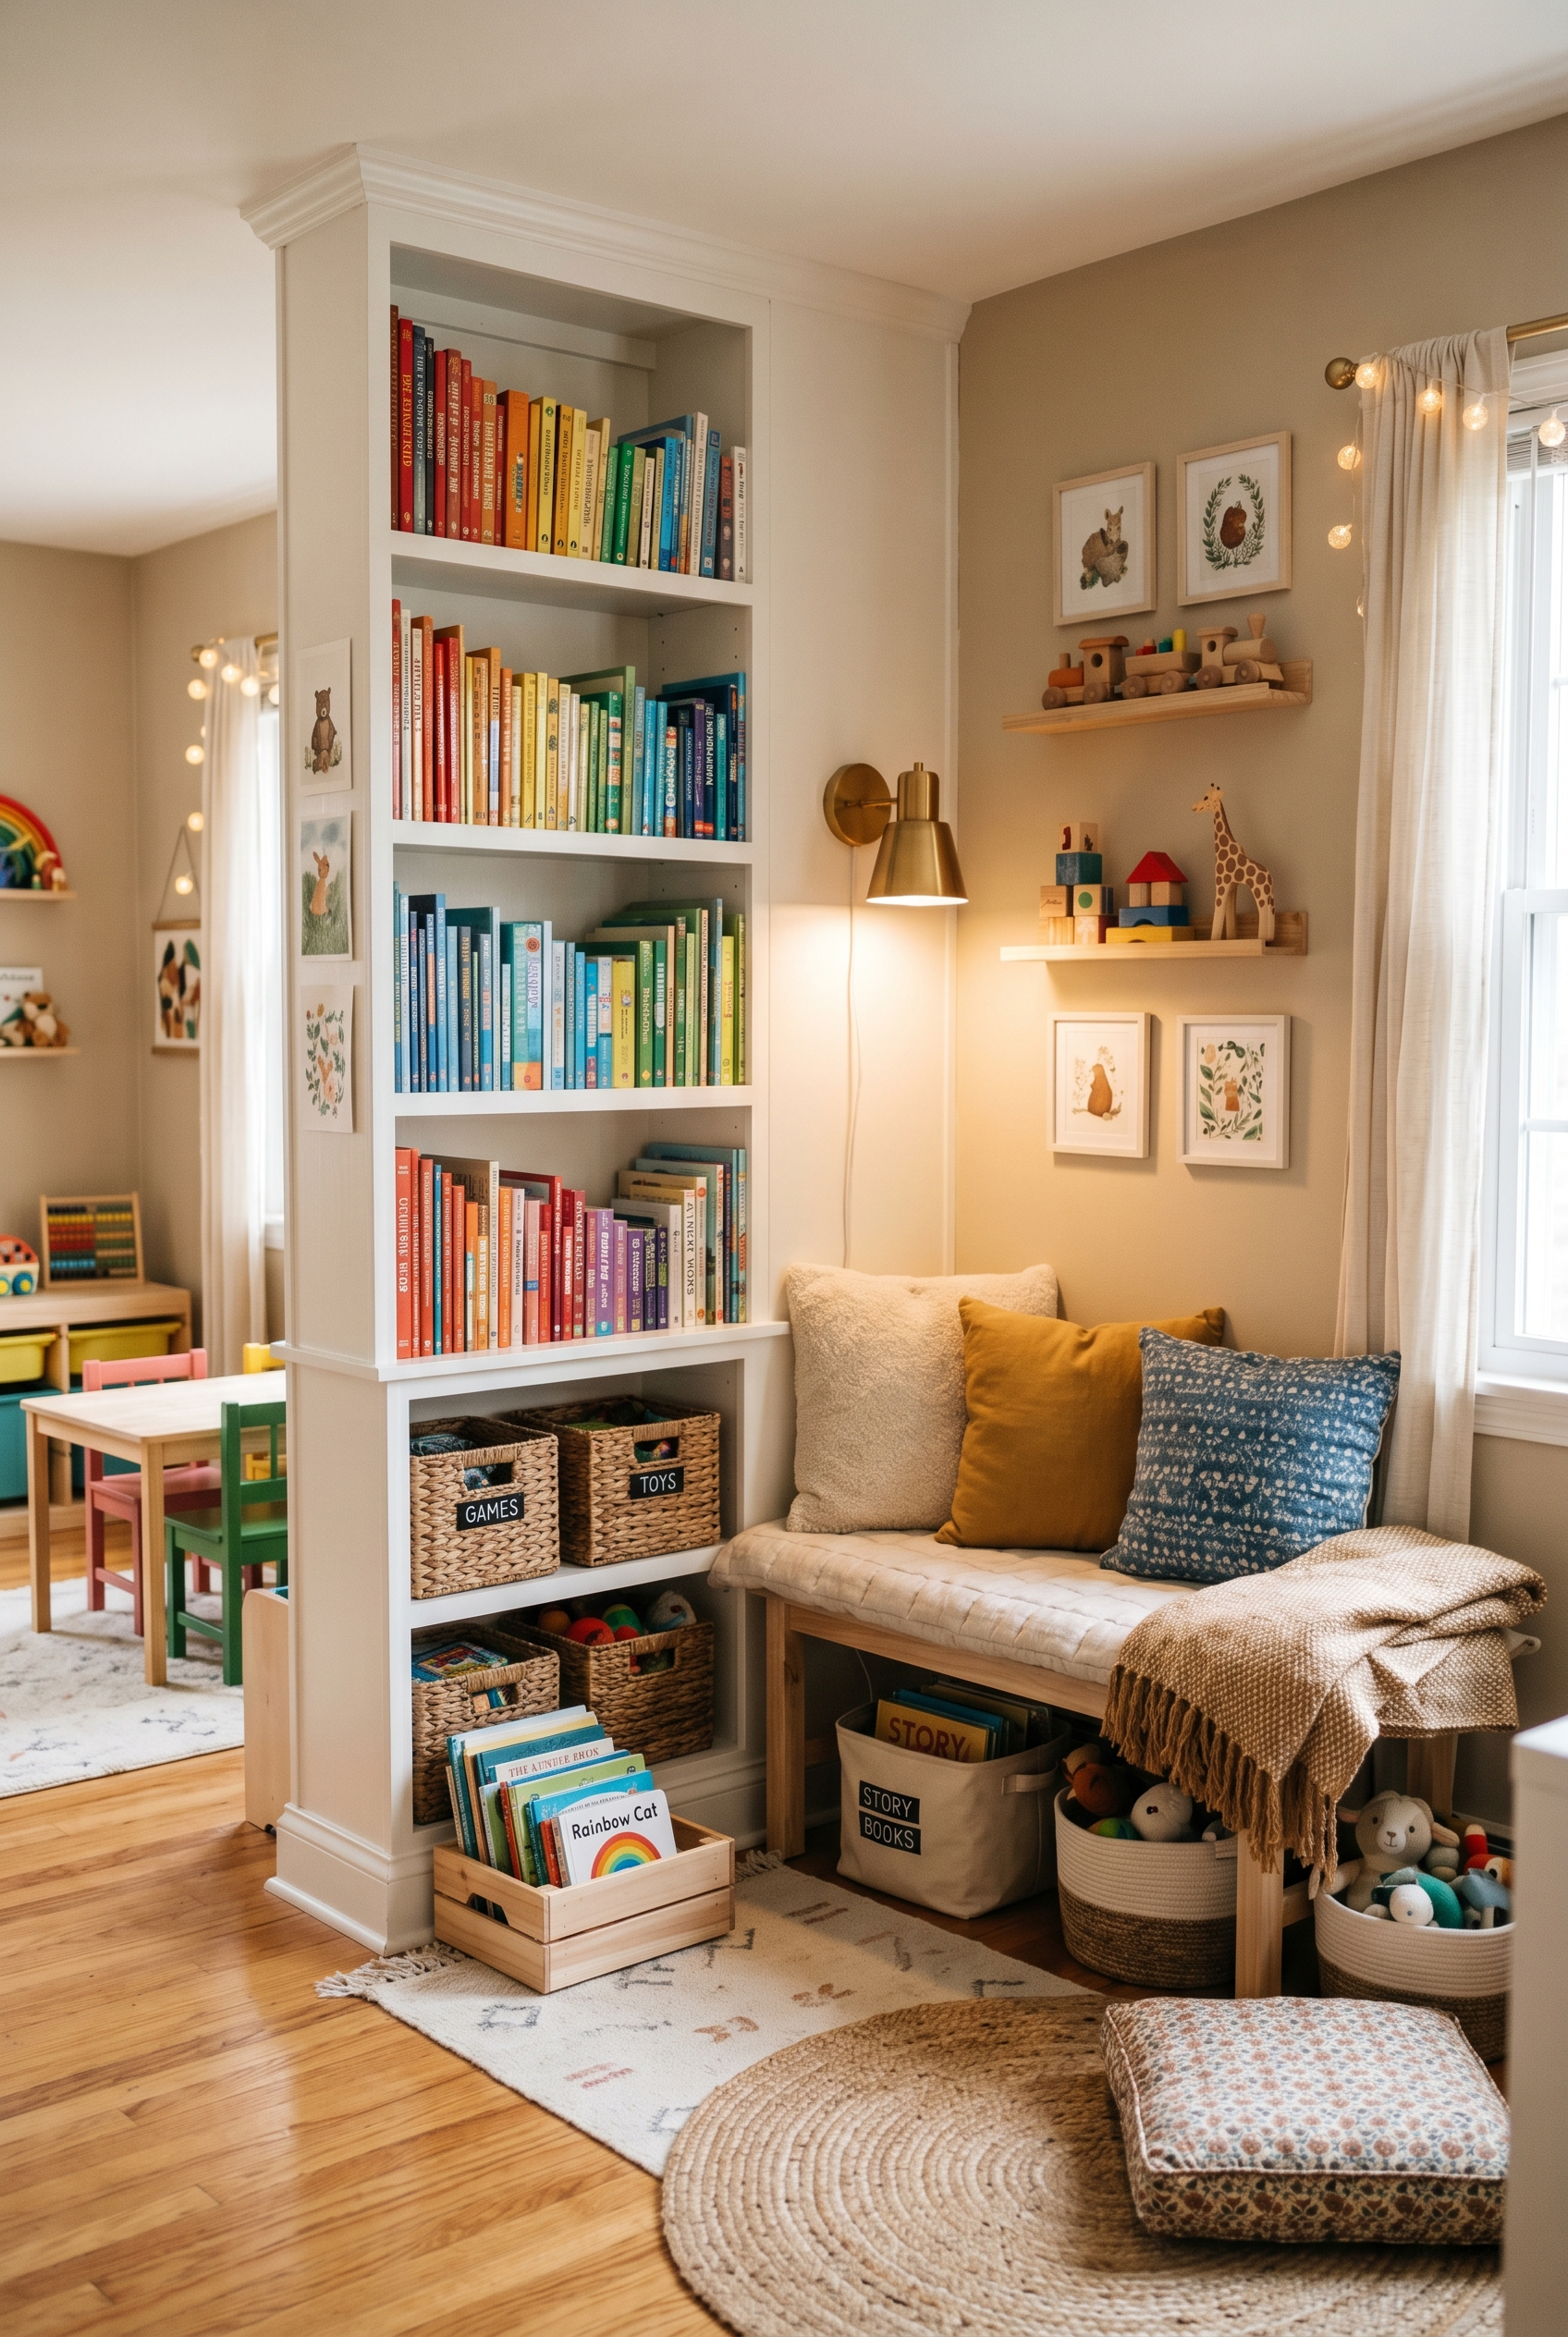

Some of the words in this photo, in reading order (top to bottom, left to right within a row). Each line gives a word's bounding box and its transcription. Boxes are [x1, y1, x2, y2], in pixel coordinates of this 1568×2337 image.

[639, 1472, 678, 1495] TOYS
[465, 1498, 519, 1524] GAMES
[887, 1716, 966, 1762] STORY
[508, 1764, 529, 1778] THE
[863, 1786, 913, 1818] STORY
[571, 1811, 631, 1841] Rainbow
[633, 1802, 658, 1822] Cat
[864, 1817, 914, 1850] BOOKS
